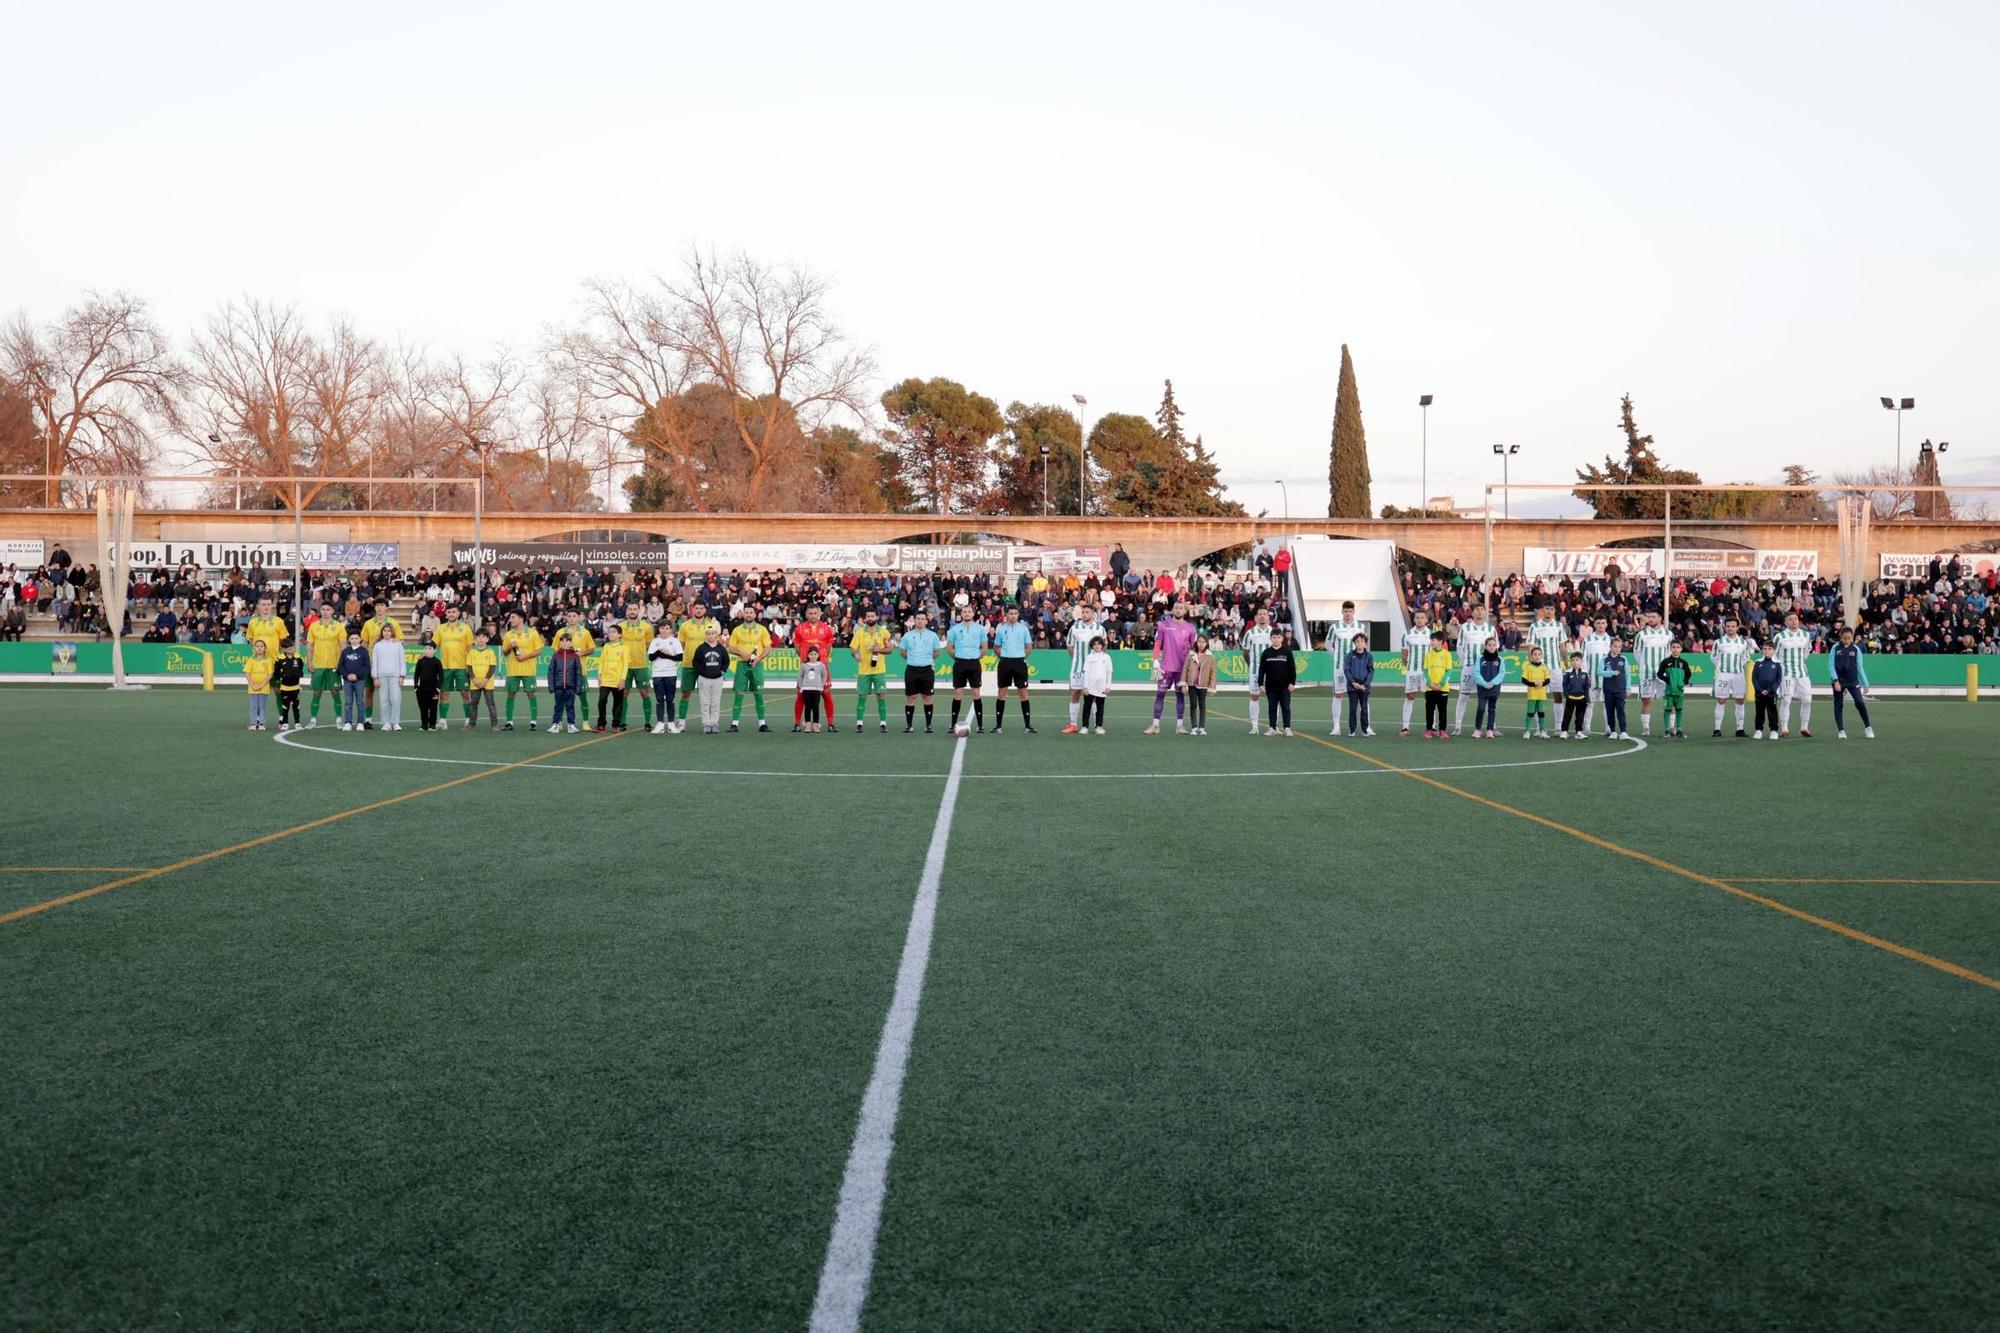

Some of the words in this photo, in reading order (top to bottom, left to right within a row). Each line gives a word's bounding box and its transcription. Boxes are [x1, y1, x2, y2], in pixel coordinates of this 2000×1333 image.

[166, 544, 195, 566] La
[207, 544, 281, 566] Unión
[586, 549, 666, 560] vinsoles.com
[902, 546, 1003, 561] Singularplus
